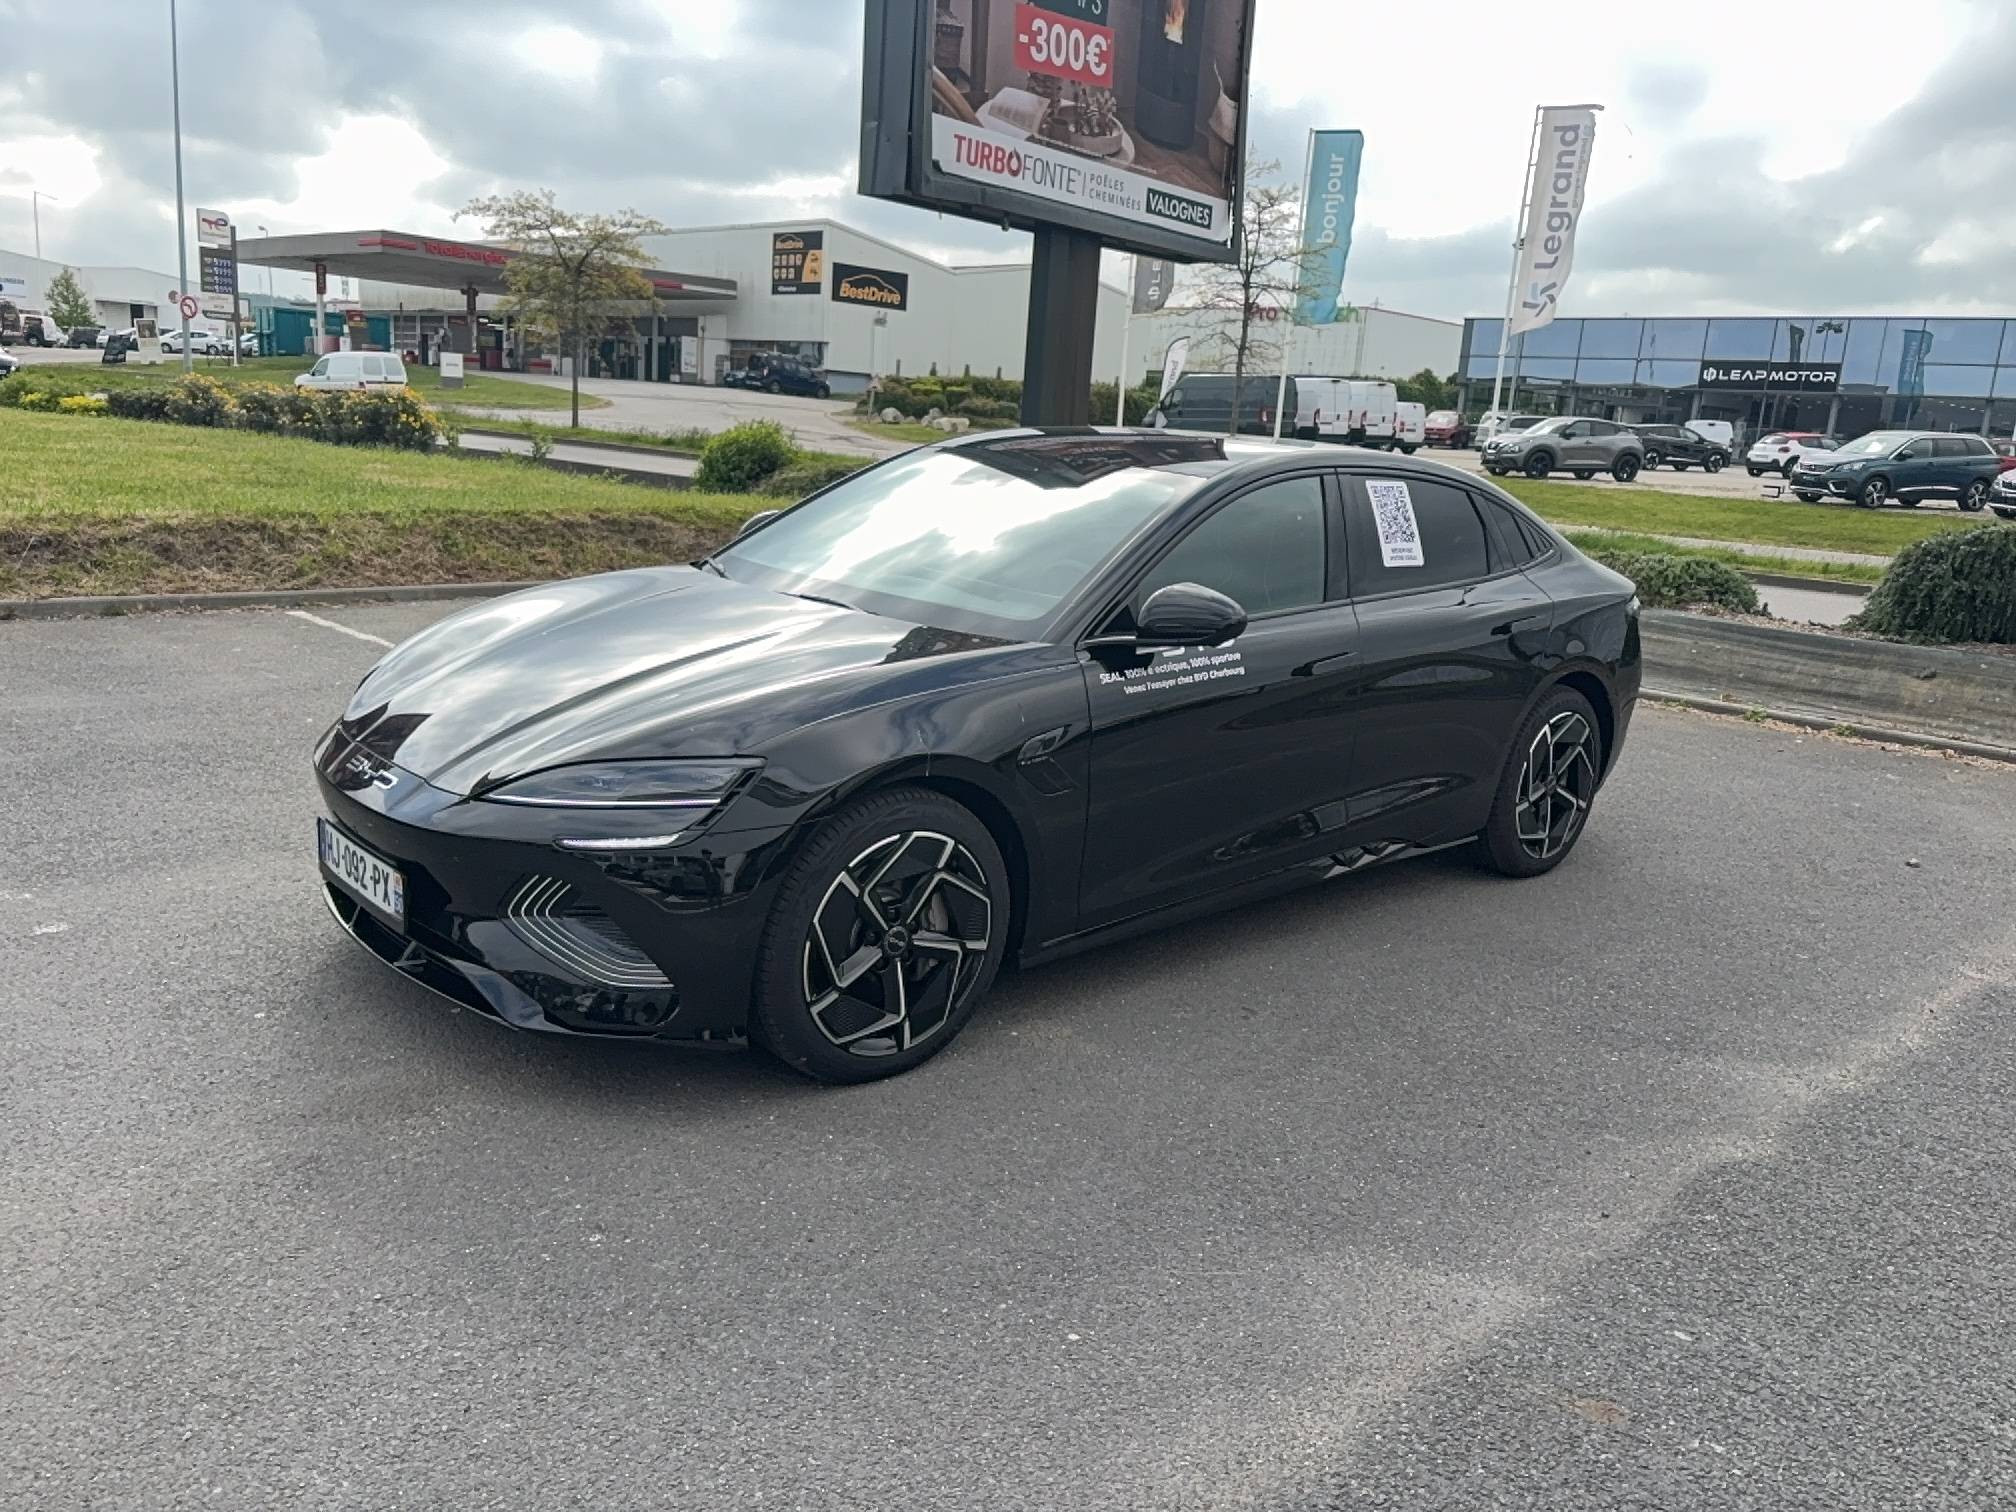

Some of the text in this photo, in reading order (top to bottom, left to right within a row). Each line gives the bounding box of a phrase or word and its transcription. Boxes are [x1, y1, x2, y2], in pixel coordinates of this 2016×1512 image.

[1089, 187, 1142, 212] CHEMINÉES
[1150, 192, 1211, 227] VALOGNES
[1316, 153, 1345, 245] bonjour
[840, 282, 901, 305] BestDrive
[1717, 369, 1838, 383] LEAPMOTOR
[1100, 673, 1125, 685] SEAL,
